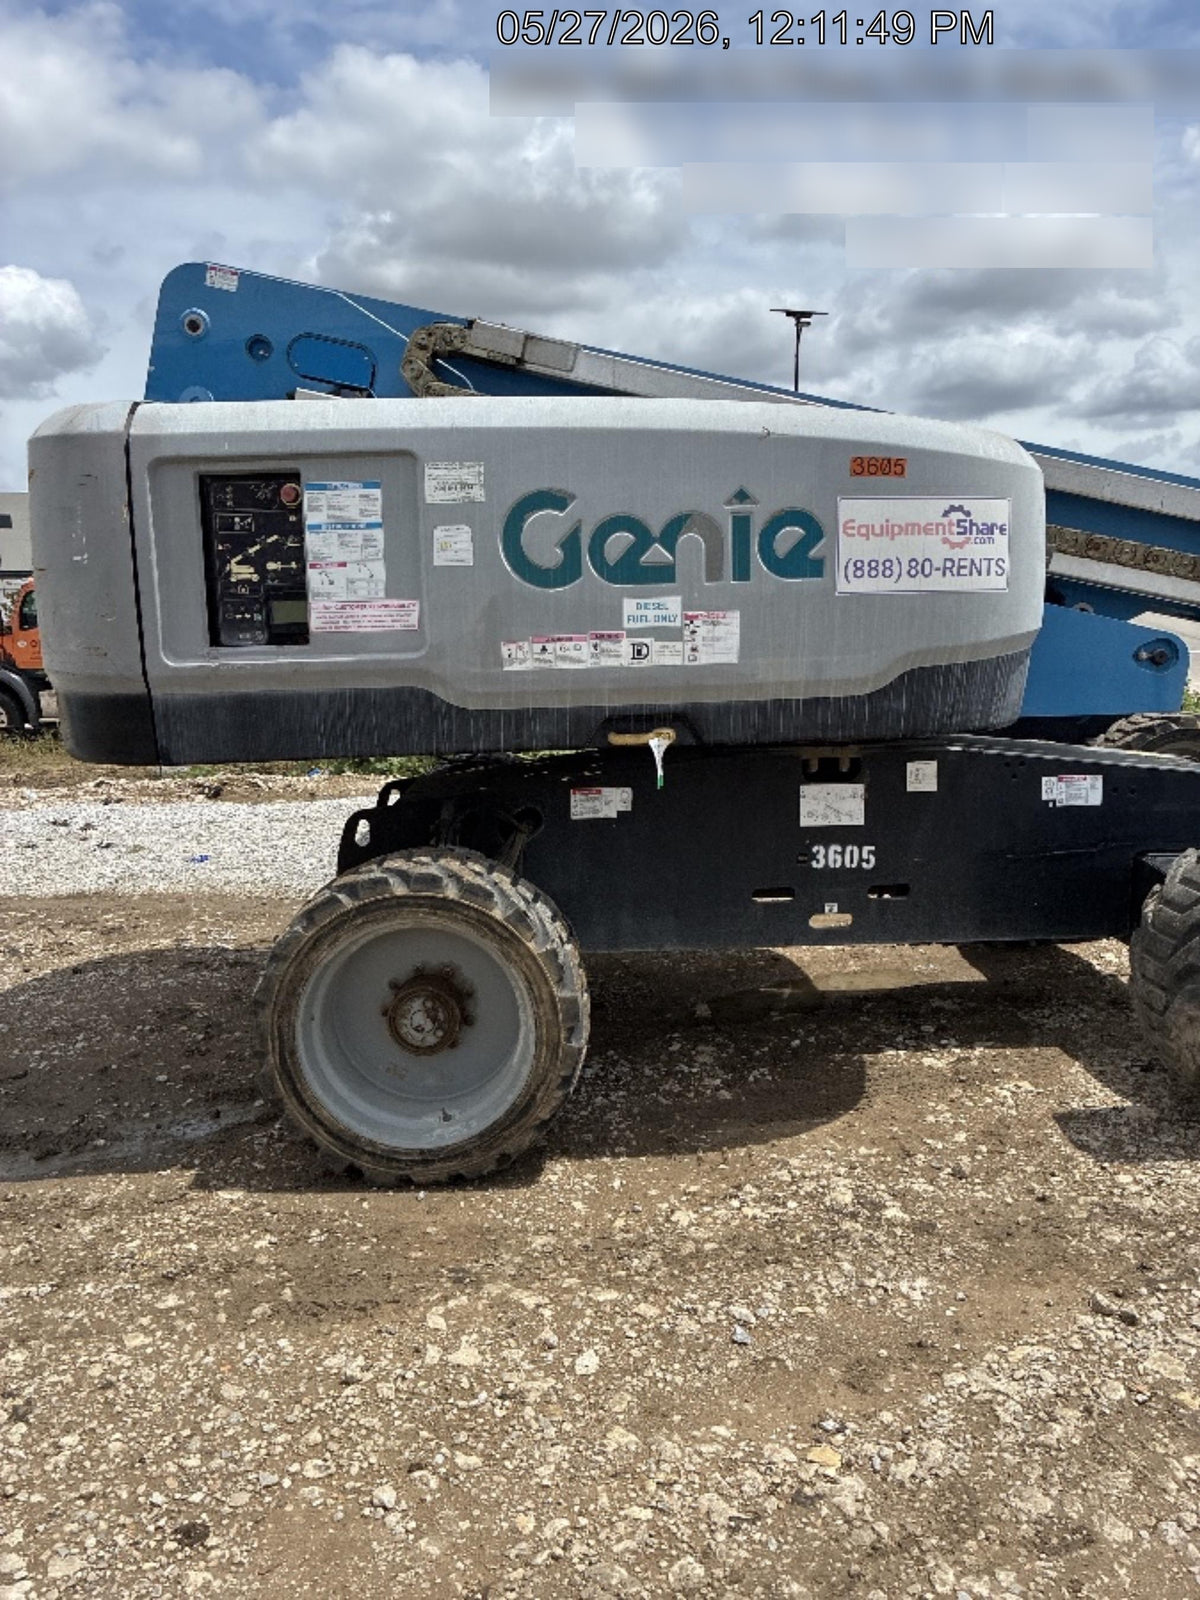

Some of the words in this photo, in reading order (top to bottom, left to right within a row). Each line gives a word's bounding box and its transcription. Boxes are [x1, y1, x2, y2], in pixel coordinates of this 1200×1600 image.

[851, 456, 906, 476] 3605
[499, 485, 826, 592] Genie
[842, 518, 1008, 541] EquipmentShare
[843, 556, 903, 584] (888)
[906, 557, 1007, 579] 80-RENTS
[635, 601, 670, 611] DIESEL
[626, 613, 650, 624] FUEL
[653, 612, 679, 623] ONLY
[810, 843, 877, 871] 3605
